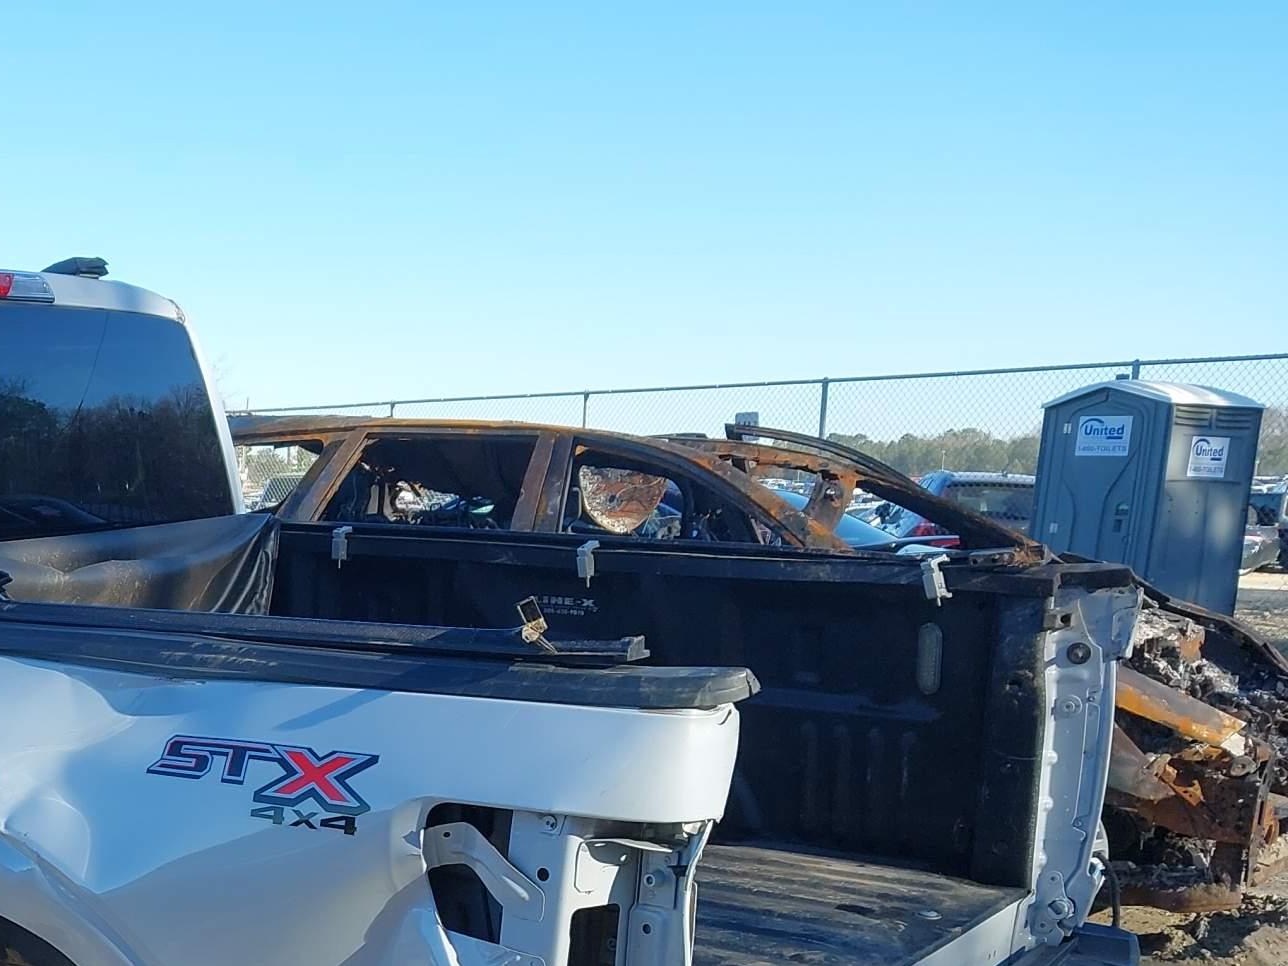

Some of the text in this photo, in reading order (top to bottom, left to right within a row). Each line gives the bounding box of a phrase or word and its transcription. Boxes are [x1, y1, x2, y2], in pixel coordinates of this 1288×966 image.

[1084, 424, 1125, 436] United
[1195, 445, 1224, 456] United
[146, 734, 379, 816] STX
